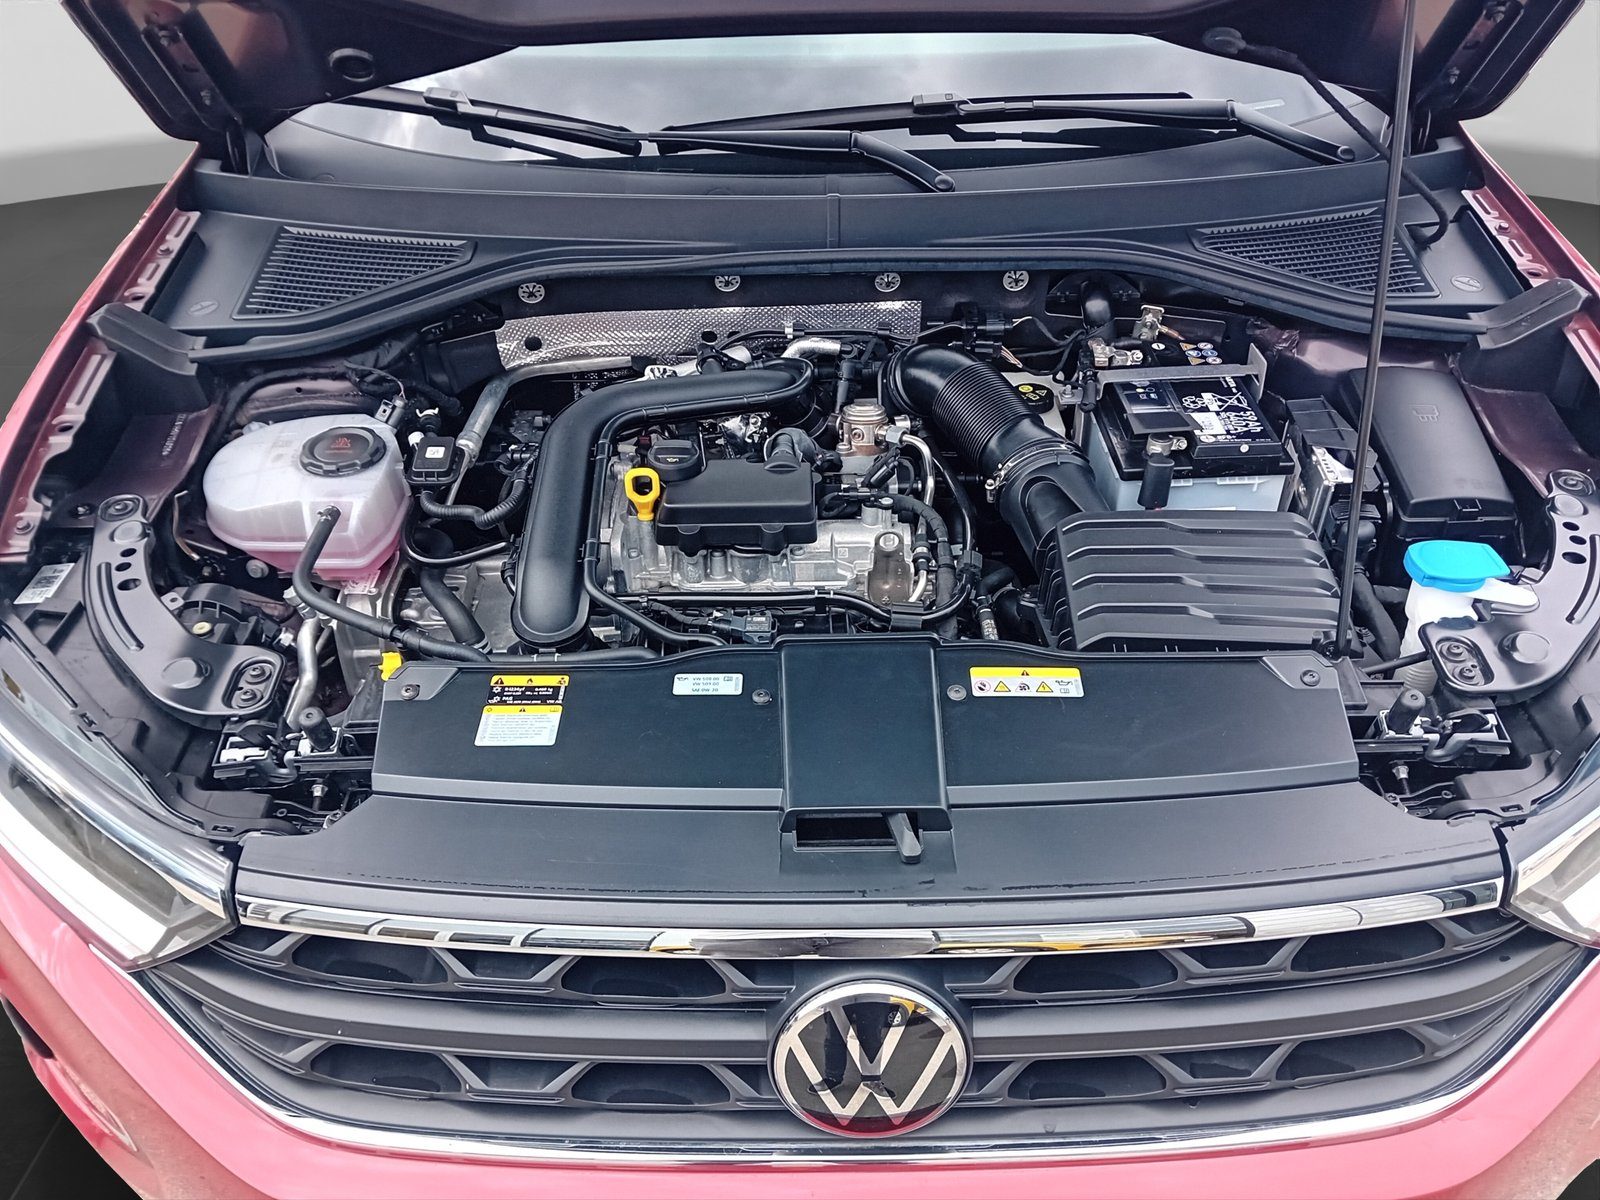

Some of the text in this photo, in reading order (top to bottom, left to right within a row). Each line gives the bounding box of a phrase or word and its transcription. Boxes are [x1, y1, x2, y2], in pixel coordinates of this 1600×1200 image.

[1226, 412, 1250, 434] 640A
[1240, 411, 1264, 432] 59Ah
[778, 984, 965, 1132] VW
